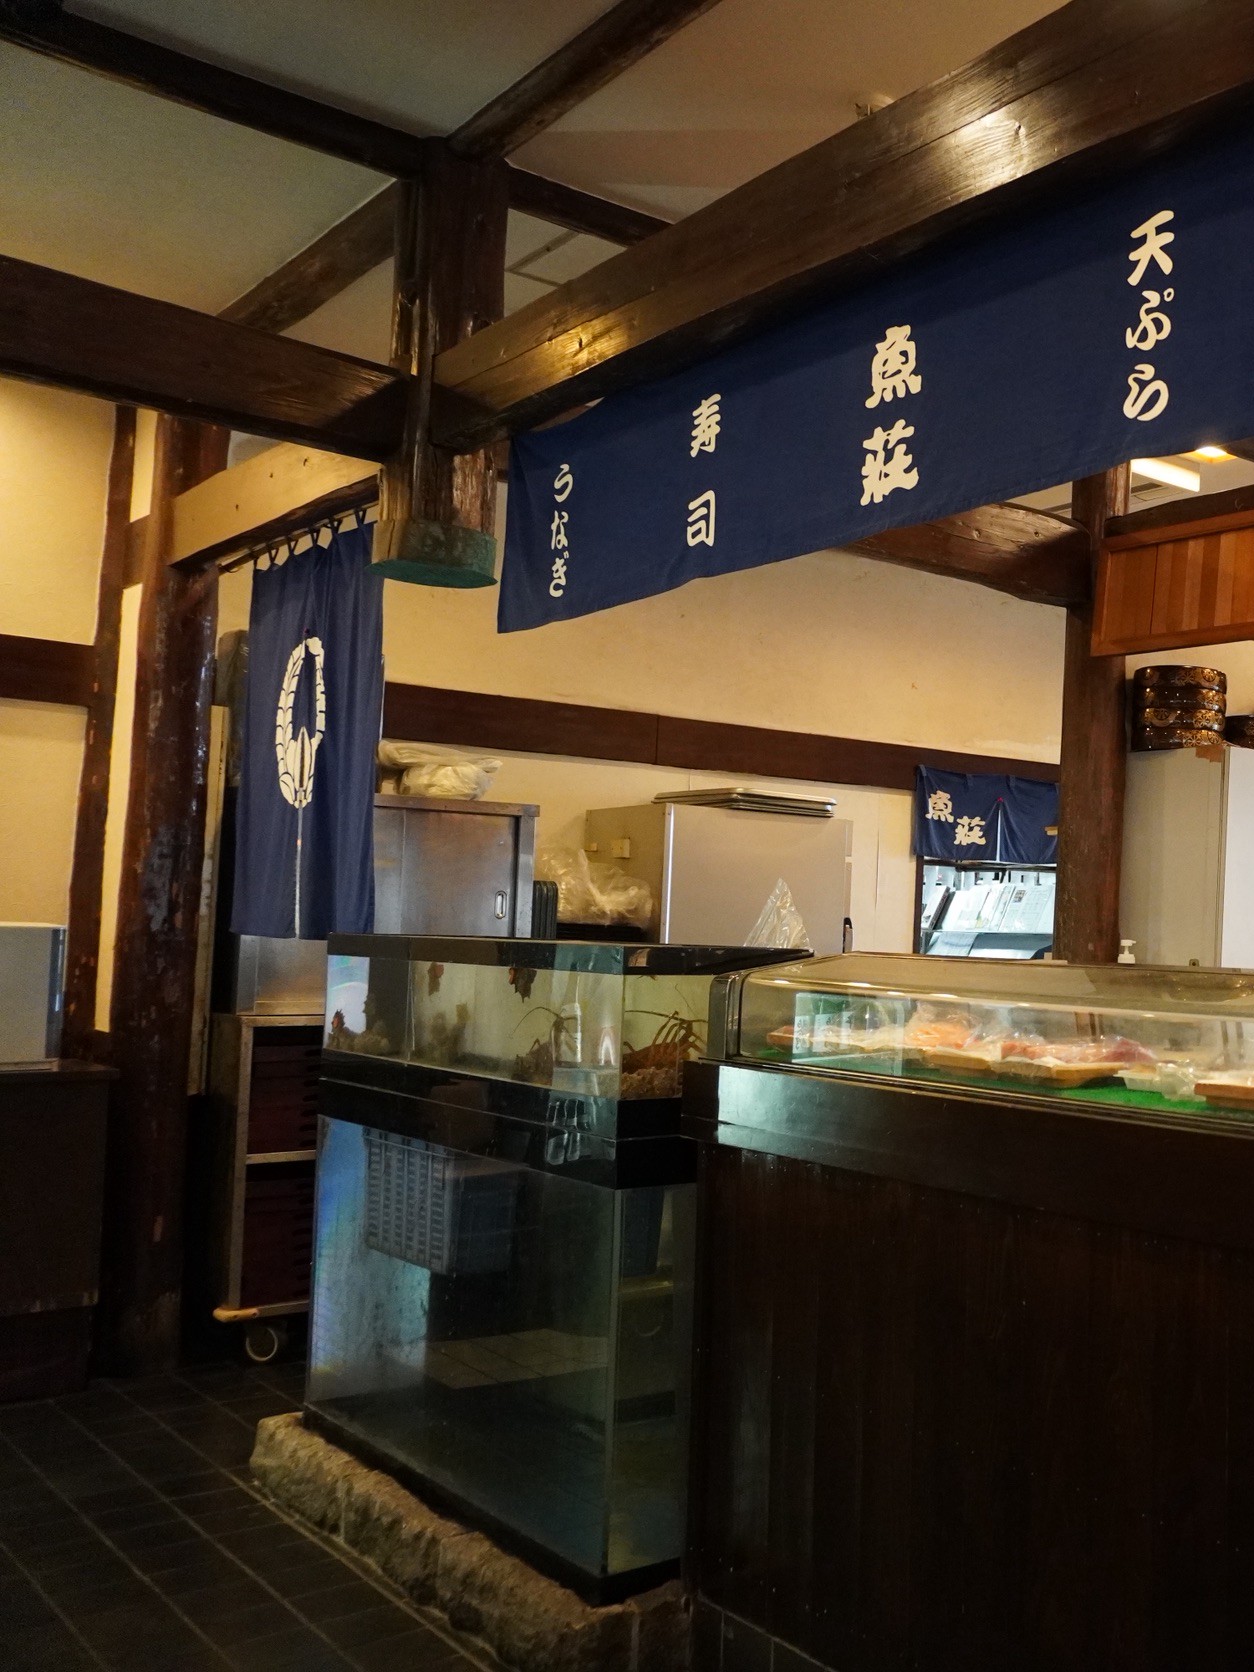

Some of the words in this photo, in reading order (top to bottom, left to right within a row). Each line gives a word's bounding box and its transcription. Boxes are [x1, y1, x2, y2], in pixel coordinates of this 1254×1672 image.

[1122, 210, 1175, 422] 天ぷら
[549, 463, 574, 598] うなぎ
[686, 393, 722, 547] 寿司
